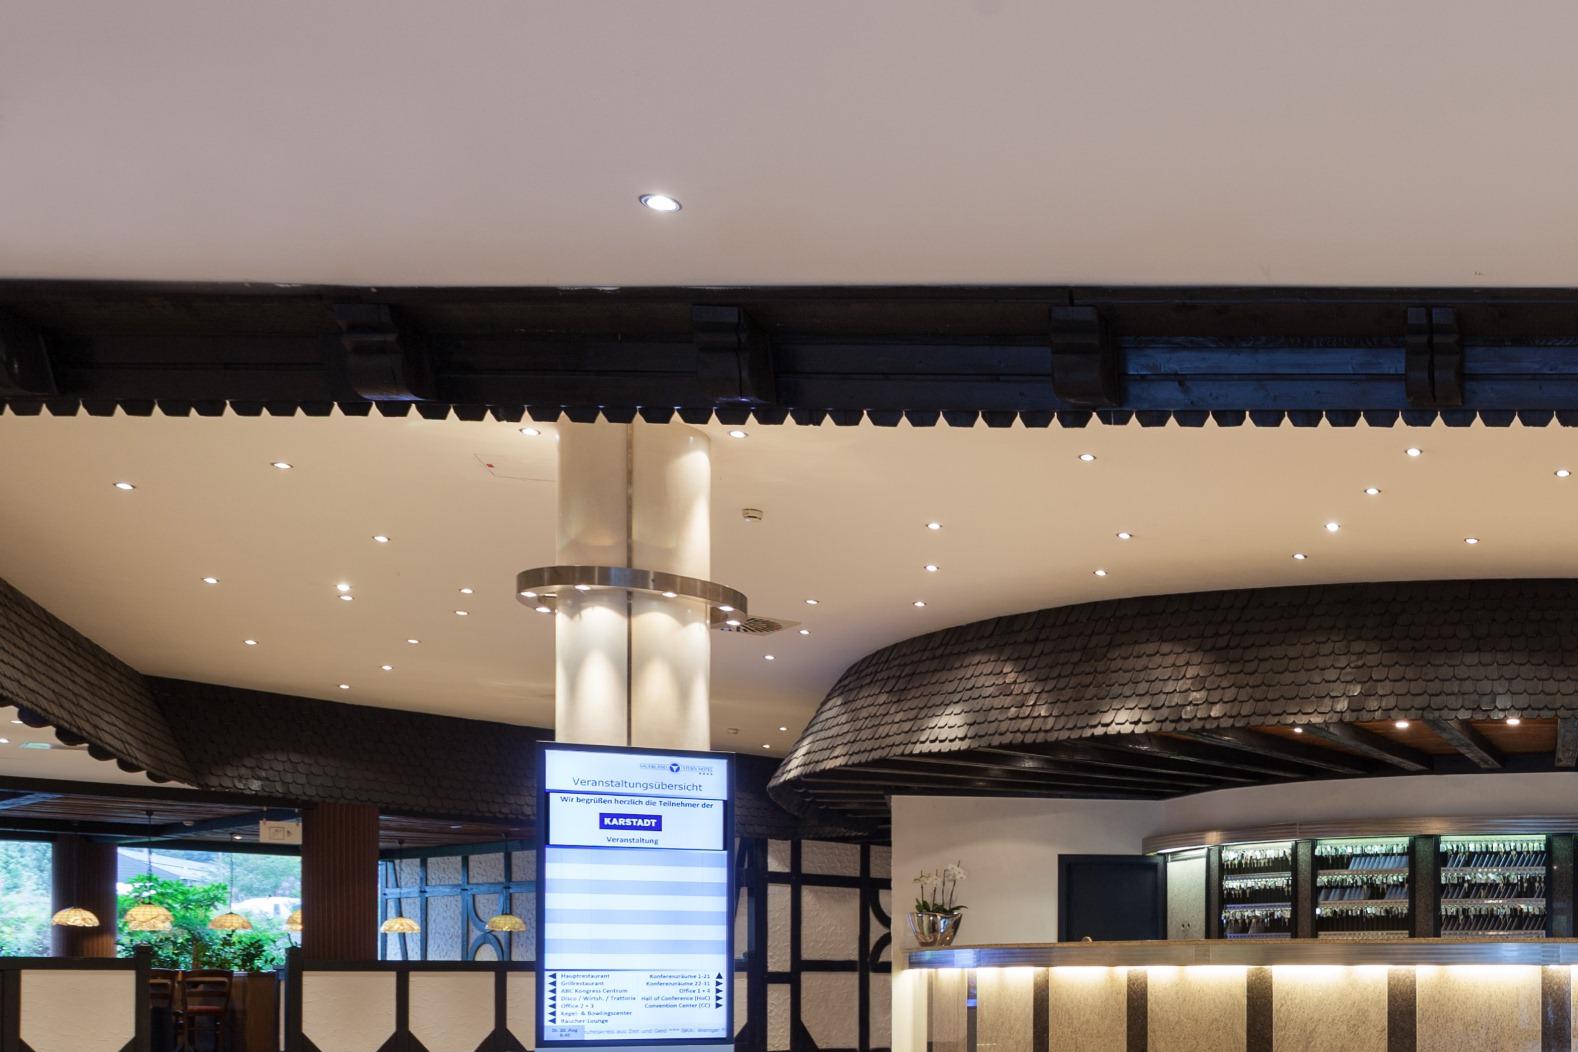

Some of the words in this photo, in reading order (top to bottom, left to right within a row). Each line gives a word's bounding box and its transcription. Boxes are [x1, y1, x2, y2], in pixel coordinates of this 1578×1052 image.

[572, 776, 703, 792] Veranstaltungsübersicht
[560, 795, 574, 803] Wir
[576, 796, 613, 805] begrüßen
[614, 798, 643, 806] herzlich
[659, 800, 700, 808] Teilnehmer
[701, 801, 714, 809] der
[604, 817, 657, 827] KARSTADT
[606, 836, 659, 845] Veranstaltung
